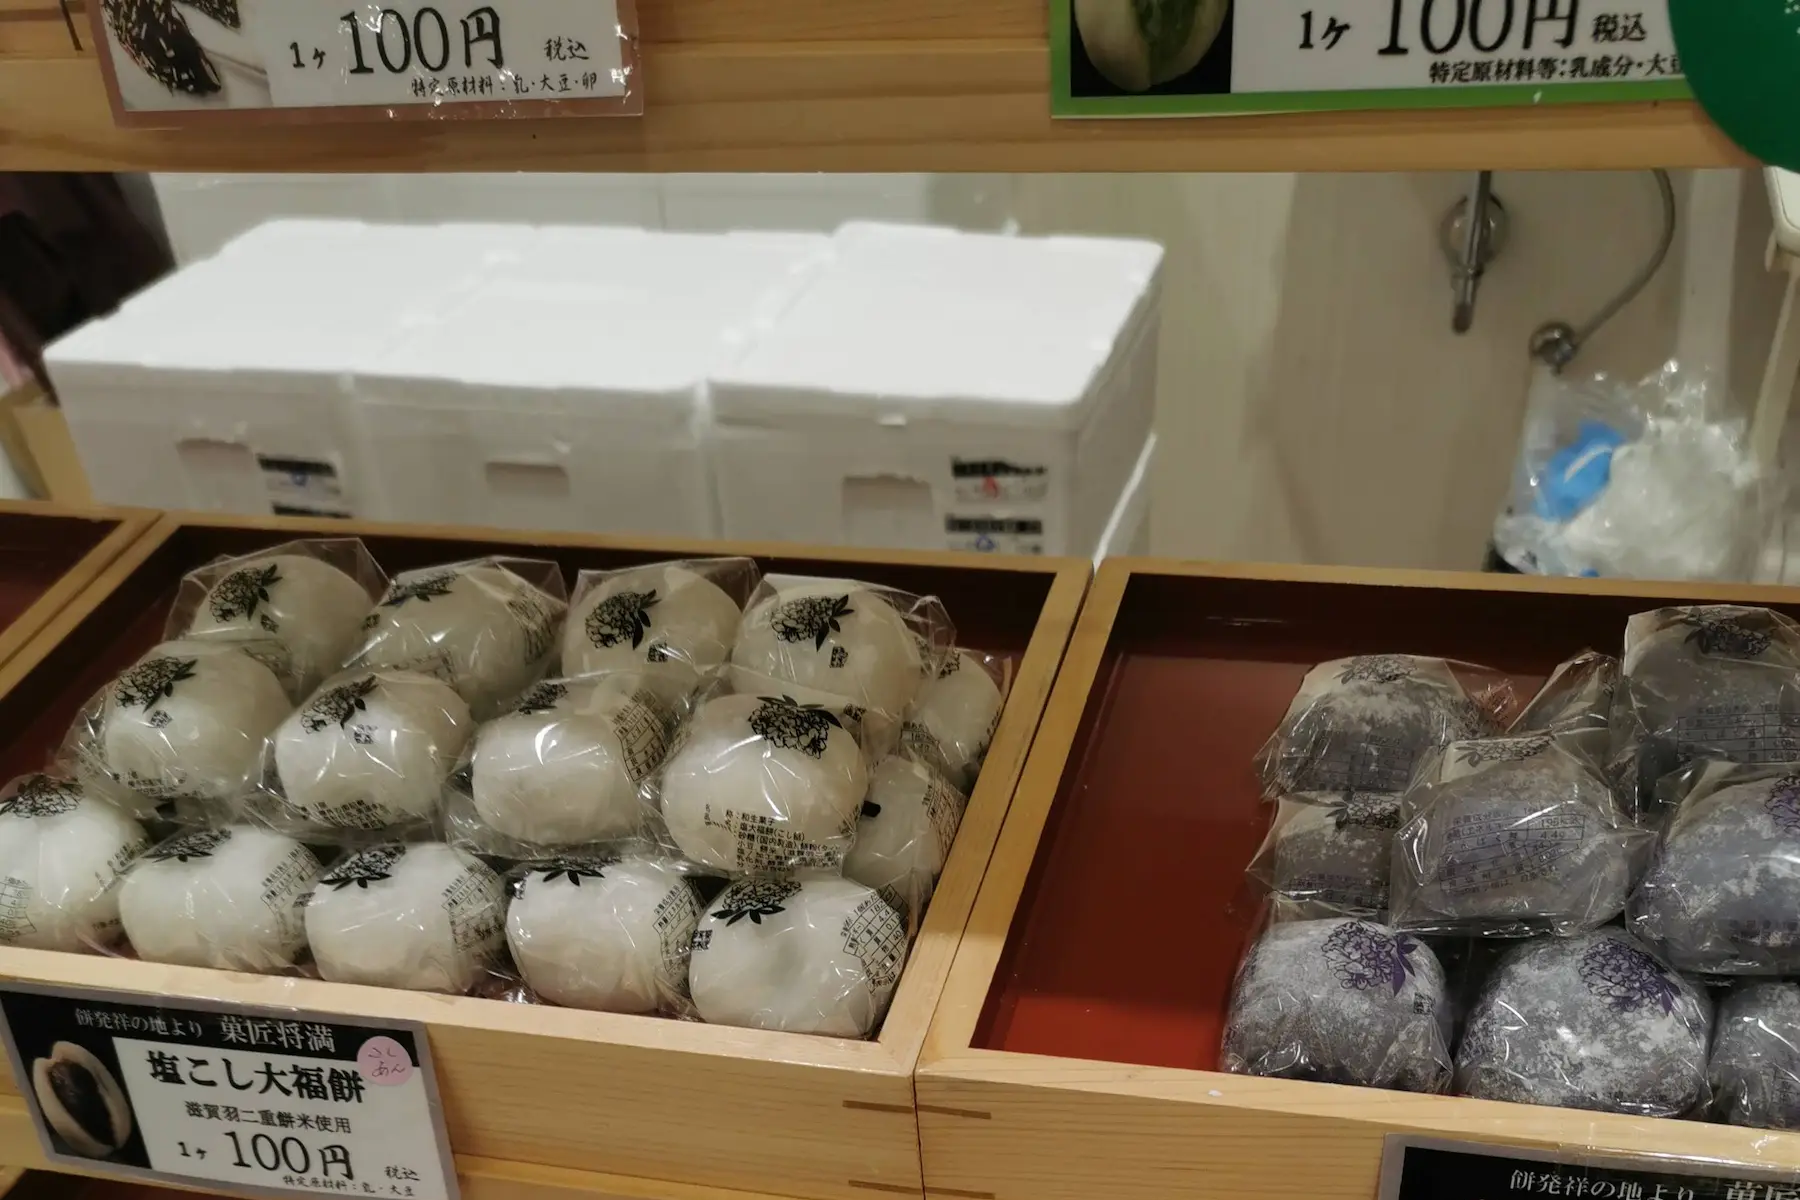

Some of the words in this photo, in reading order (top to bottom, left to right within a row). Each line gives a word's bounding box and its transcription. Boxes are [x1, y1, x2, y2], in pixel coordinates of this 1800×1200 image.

[339, 7, 502, 76] 100円
[543, 37, 590, 63] 税込
[1377, 0, 1577, 56] 100円
[1590, 12, 1648, 44] 税込
[75, 1008, 203, 1039] 餅発祥の地より
[220, 1015, 337, 1054] 菓匠将満
[146, 1050, 366, 1105] 塩こし大福餅
[371, 1060, 406, 1078] あん
[185, 1101, 352, 1135] 滋賀羽二重餅米使用
[224, 1131, 355, 1182] 100円
[384, 1165, 421, 1182] 税込
